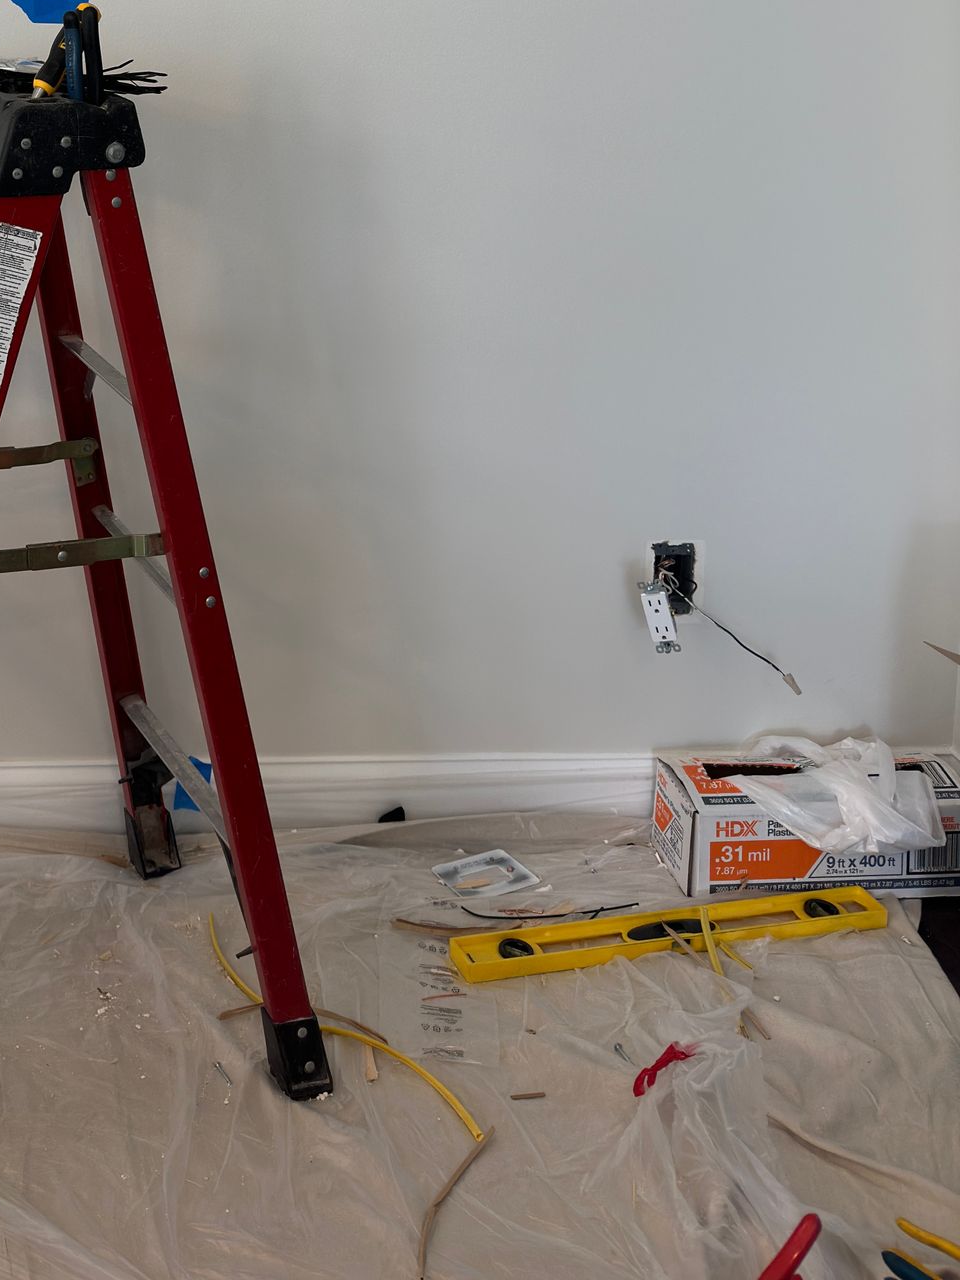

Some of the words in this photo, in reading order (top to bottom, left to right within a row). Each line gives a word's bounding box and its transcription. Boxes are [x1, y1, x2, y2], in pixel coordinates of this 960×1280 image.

[700, 780, 722, 789] 7.87
[715, 819, 759, 838] HDX
[715, 845, 743, 863] .31
[748, 848, 770, 862] mil
[826, 855, 836, 869] 9
[837, 858, 846, 869] ft
[859, 854, 886, 868] 400
[887, 856, 896, 867] ft
[715, 866, 735, 876] 7.87
